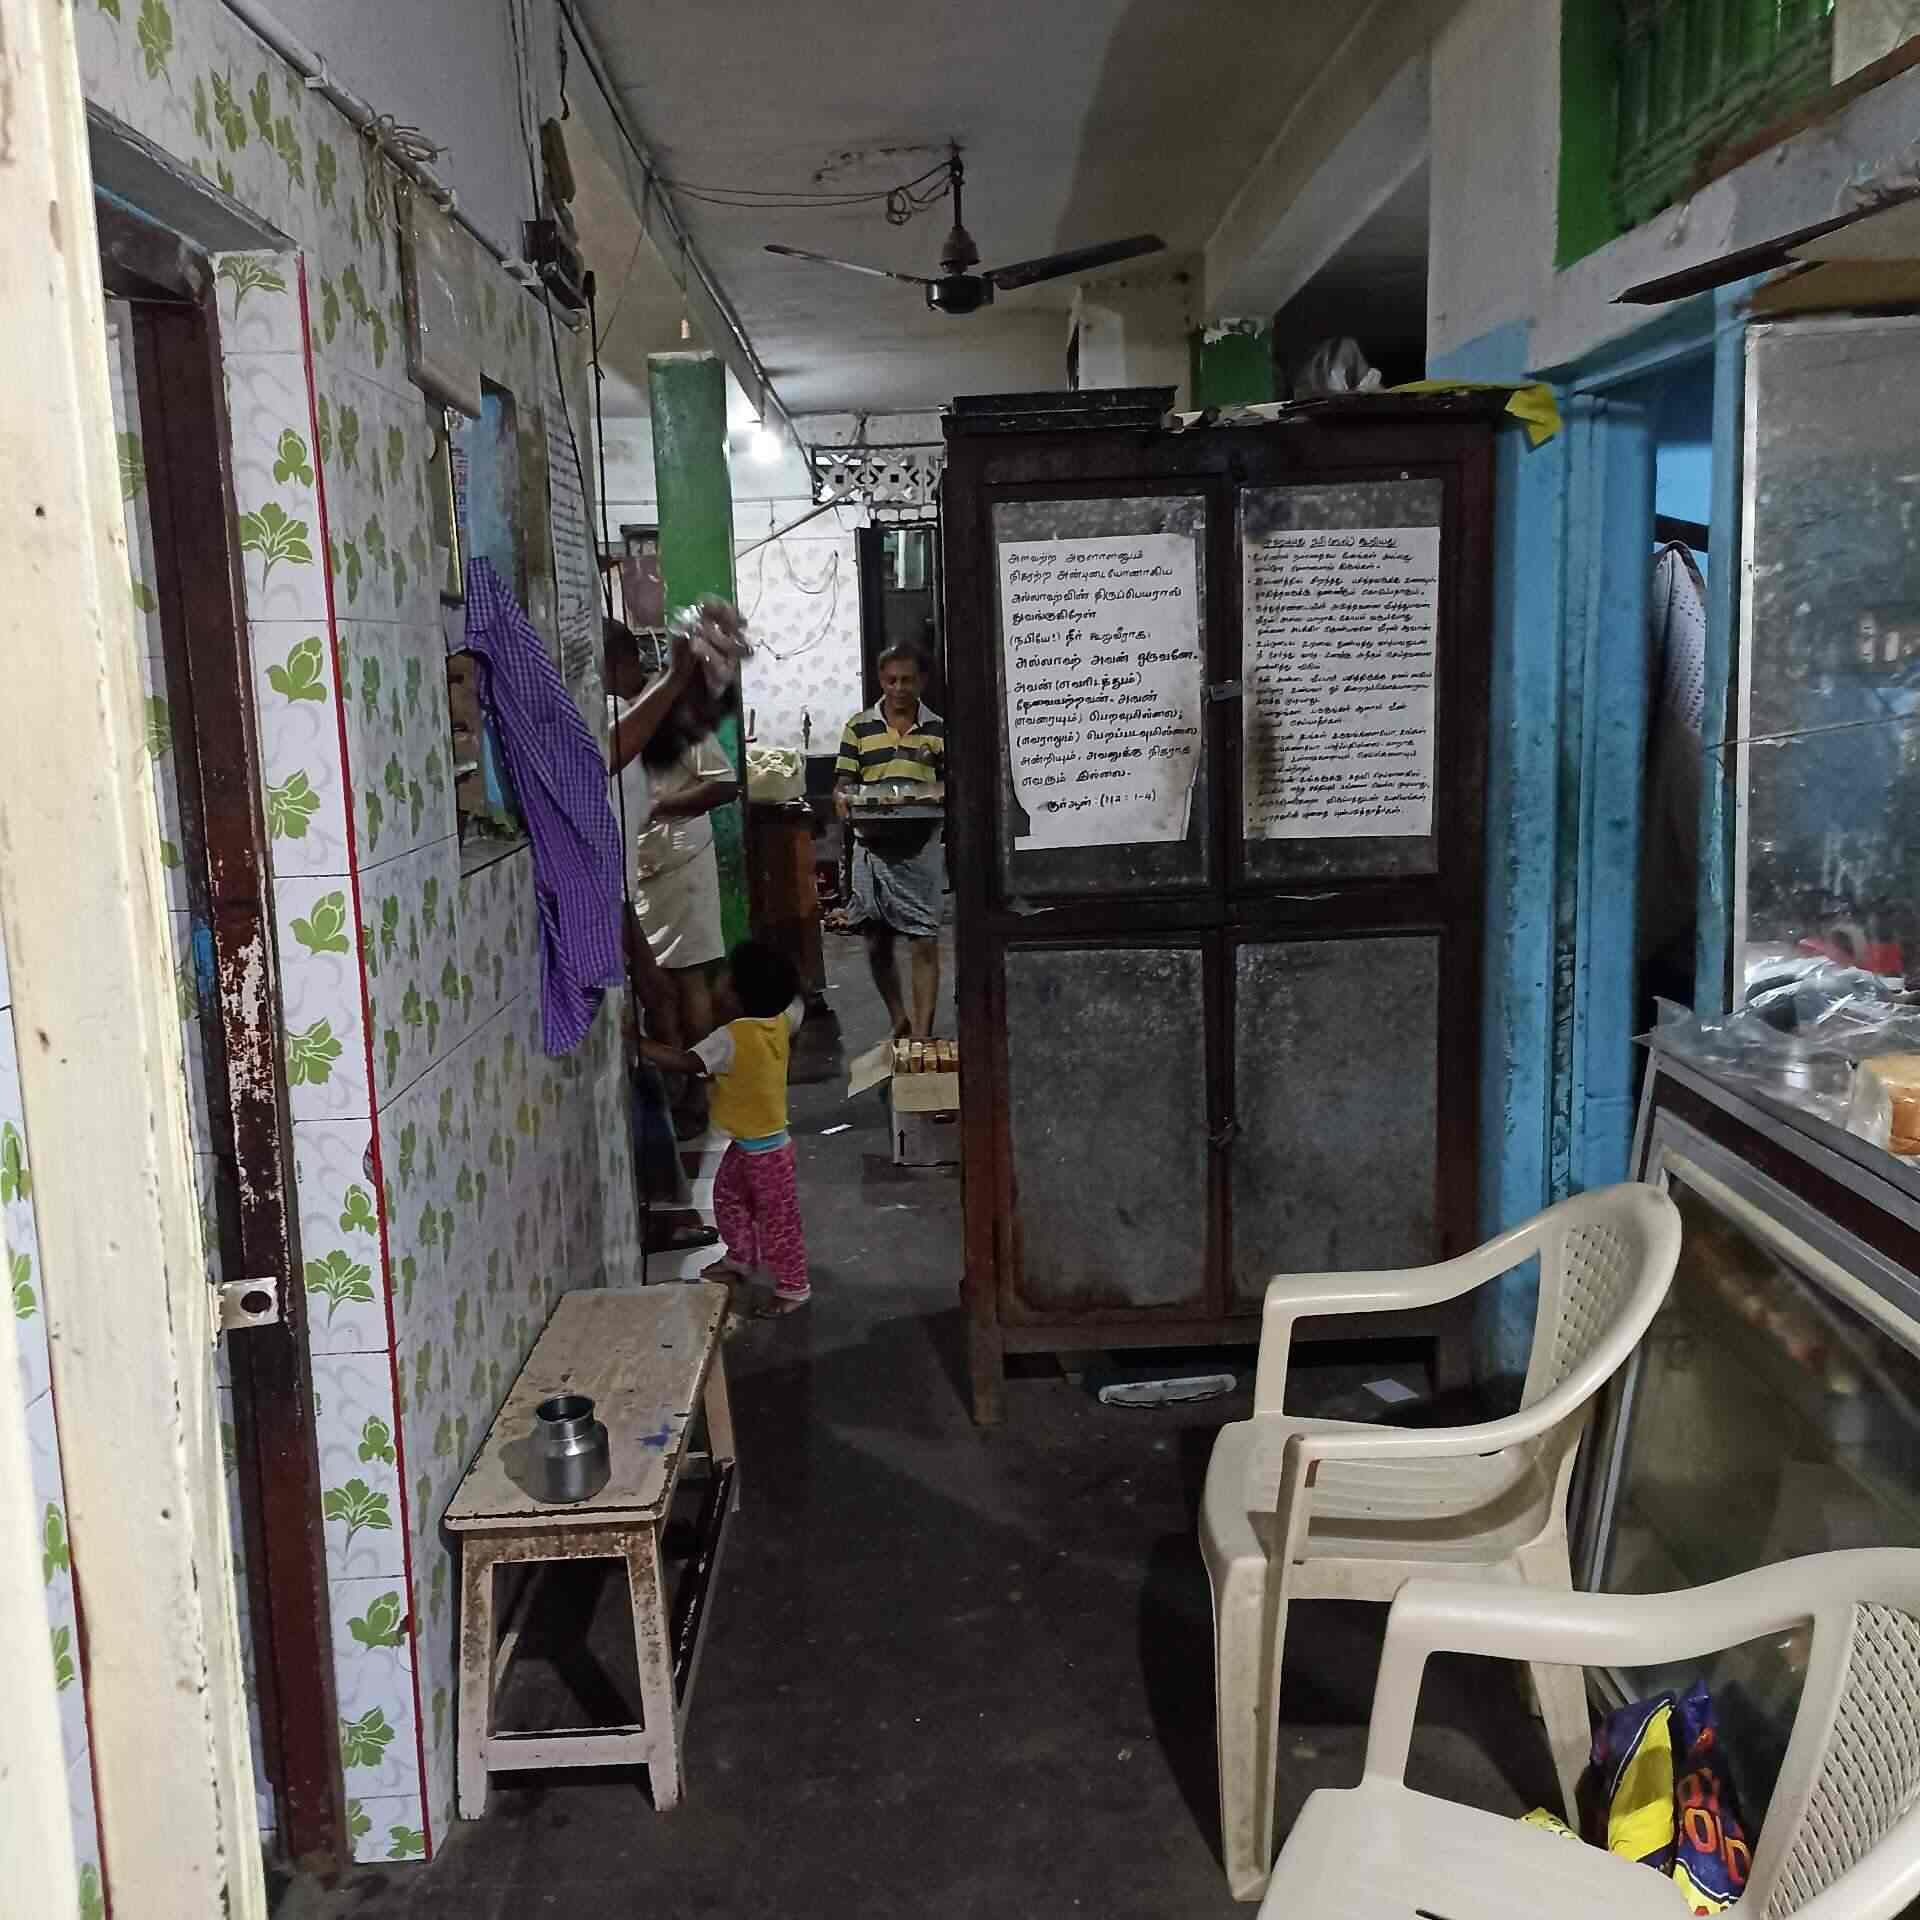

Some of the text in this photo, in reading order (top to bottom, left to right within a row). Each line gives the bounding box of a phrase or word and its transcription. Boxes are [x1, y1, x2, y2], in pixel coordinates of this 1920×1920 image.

[1016, 653, 1081, 670] அல்லாஹ்
[1091, 651, 1129, 666] அவன்
[1014, 678, 1052, 693] அவன்
[1118, 689, 1158, 704] அவன்
[1022, 772, 1066, 786] எவரும்
